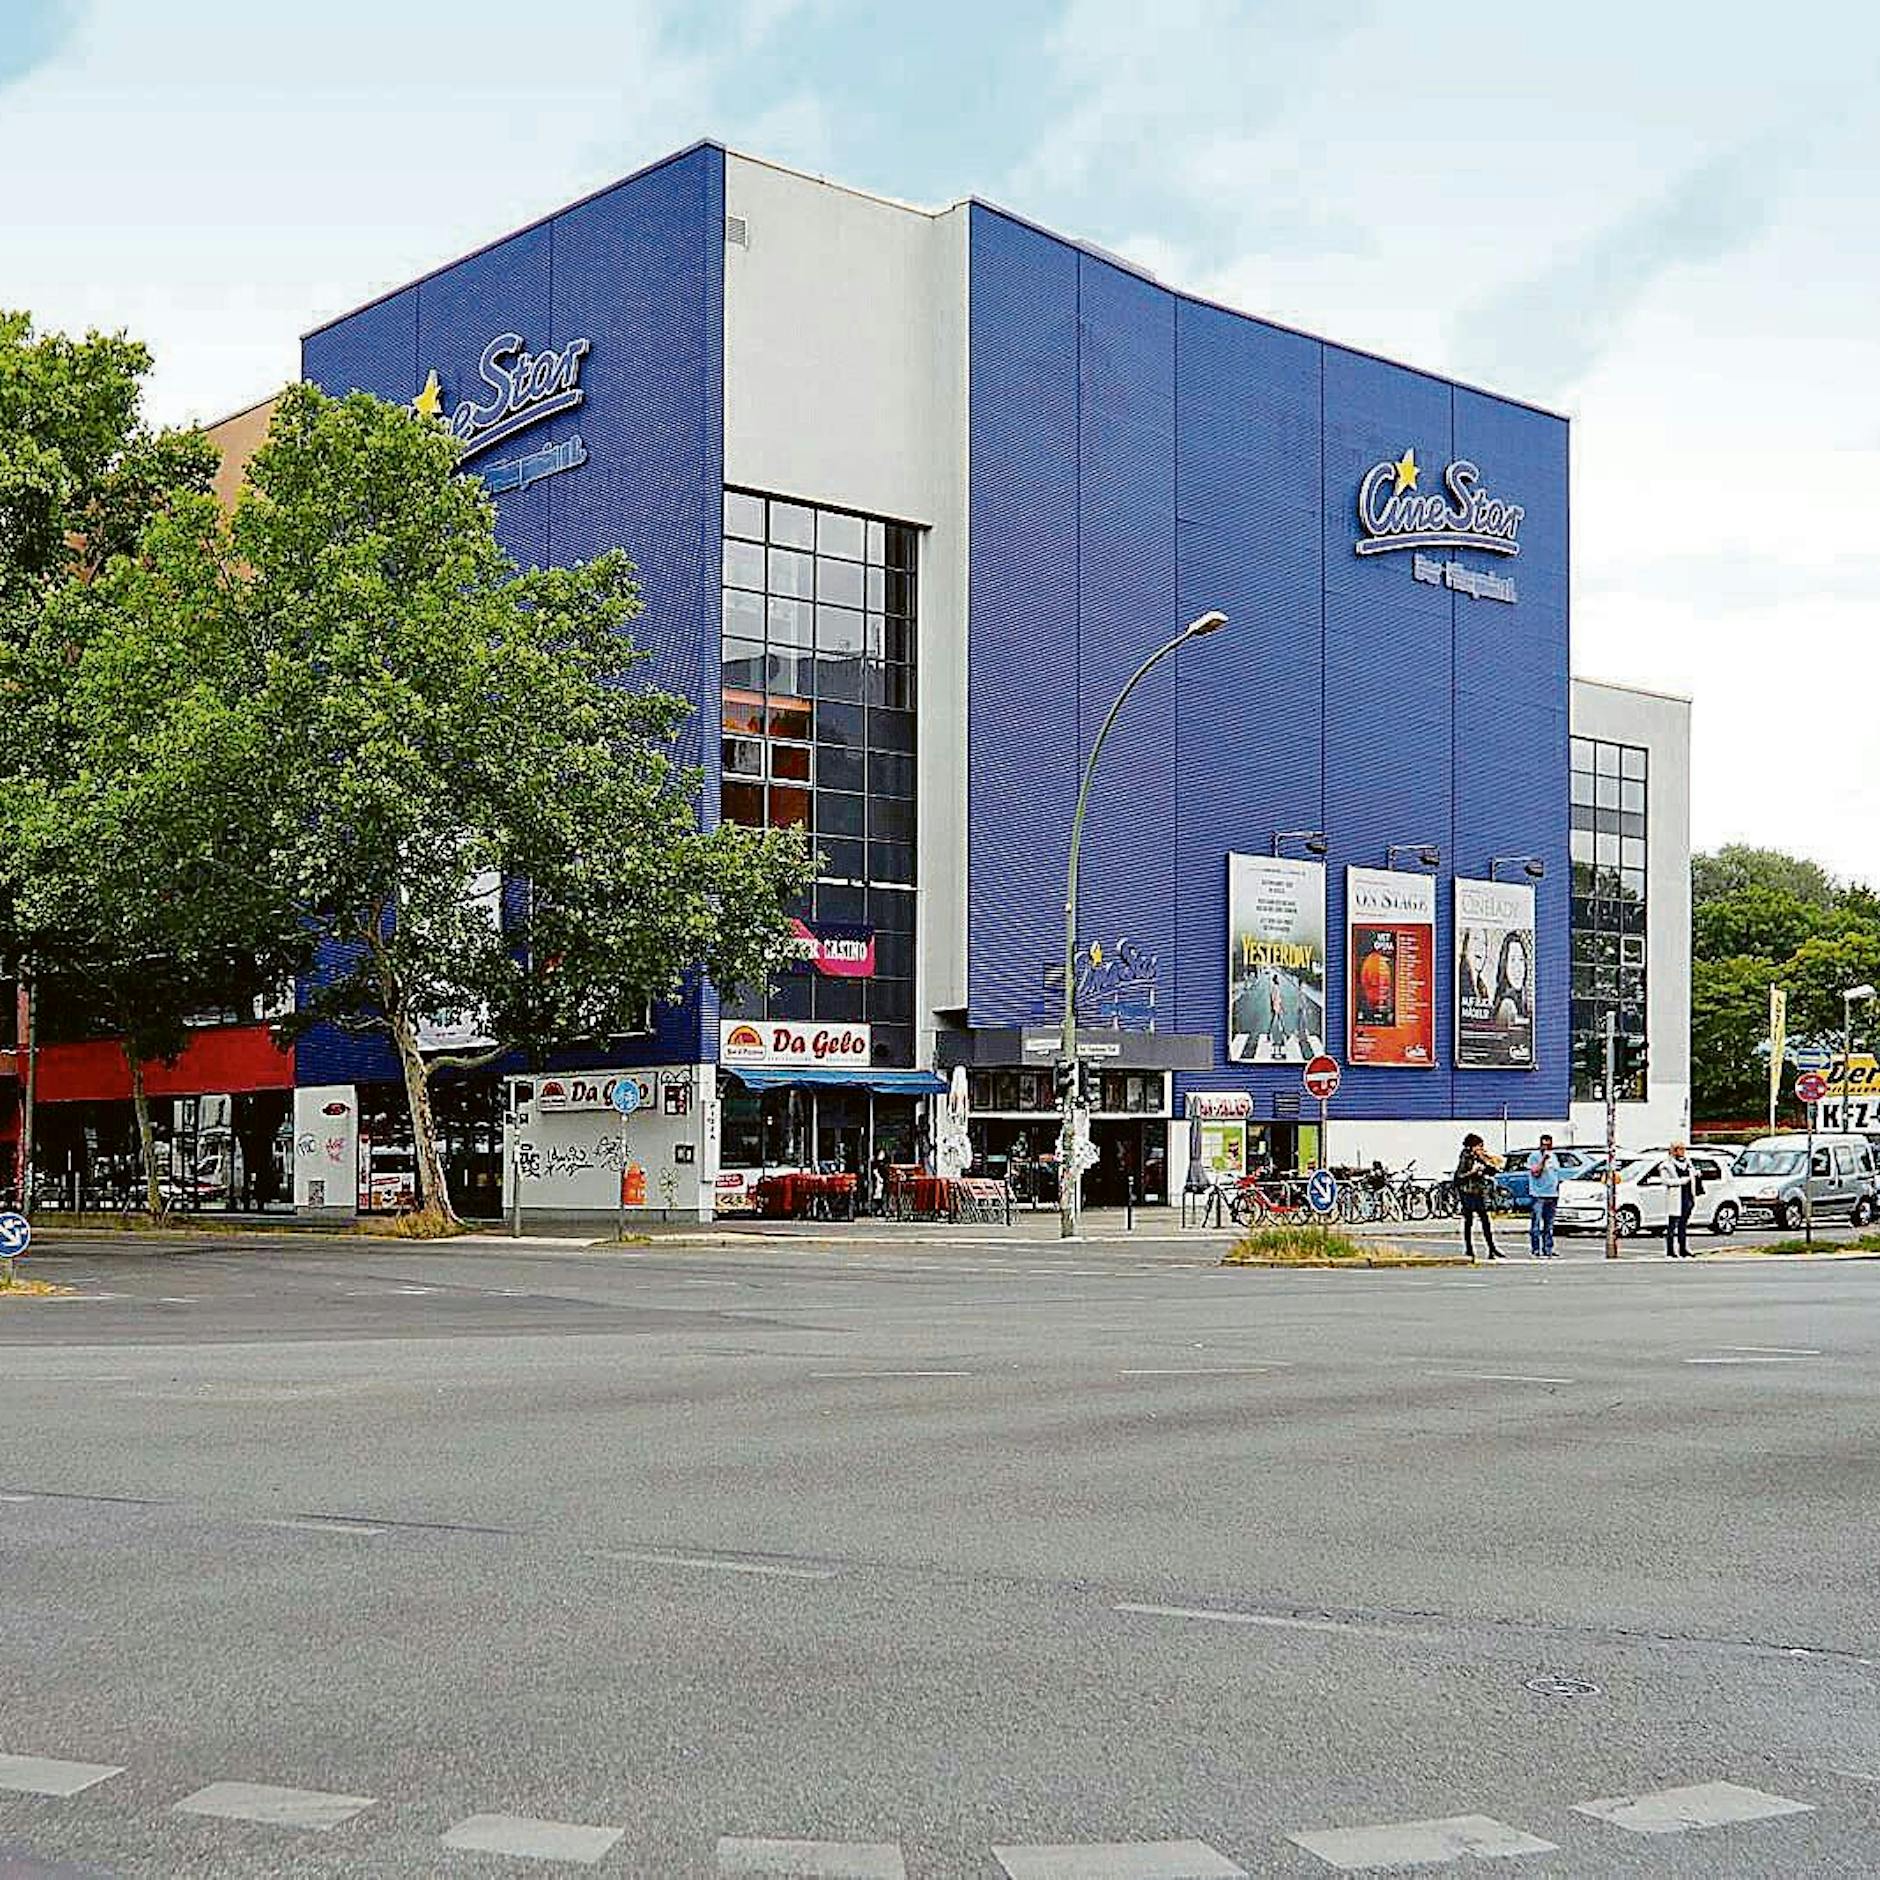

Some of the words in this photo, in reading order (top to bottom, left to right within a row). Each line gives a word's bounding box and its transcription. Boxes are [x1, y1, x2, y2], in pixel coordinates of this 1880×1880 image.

[1359, 447, 1525, 539] CineStar
[822, 938, 868, 961] CASINO
[1241, 932, 1314, 969] YESTERDAY
[773, 1029, 806, 1053] Da
[812, 1030, 865, 1058] Gelo
[572, 1081, 598, 1101] Da
